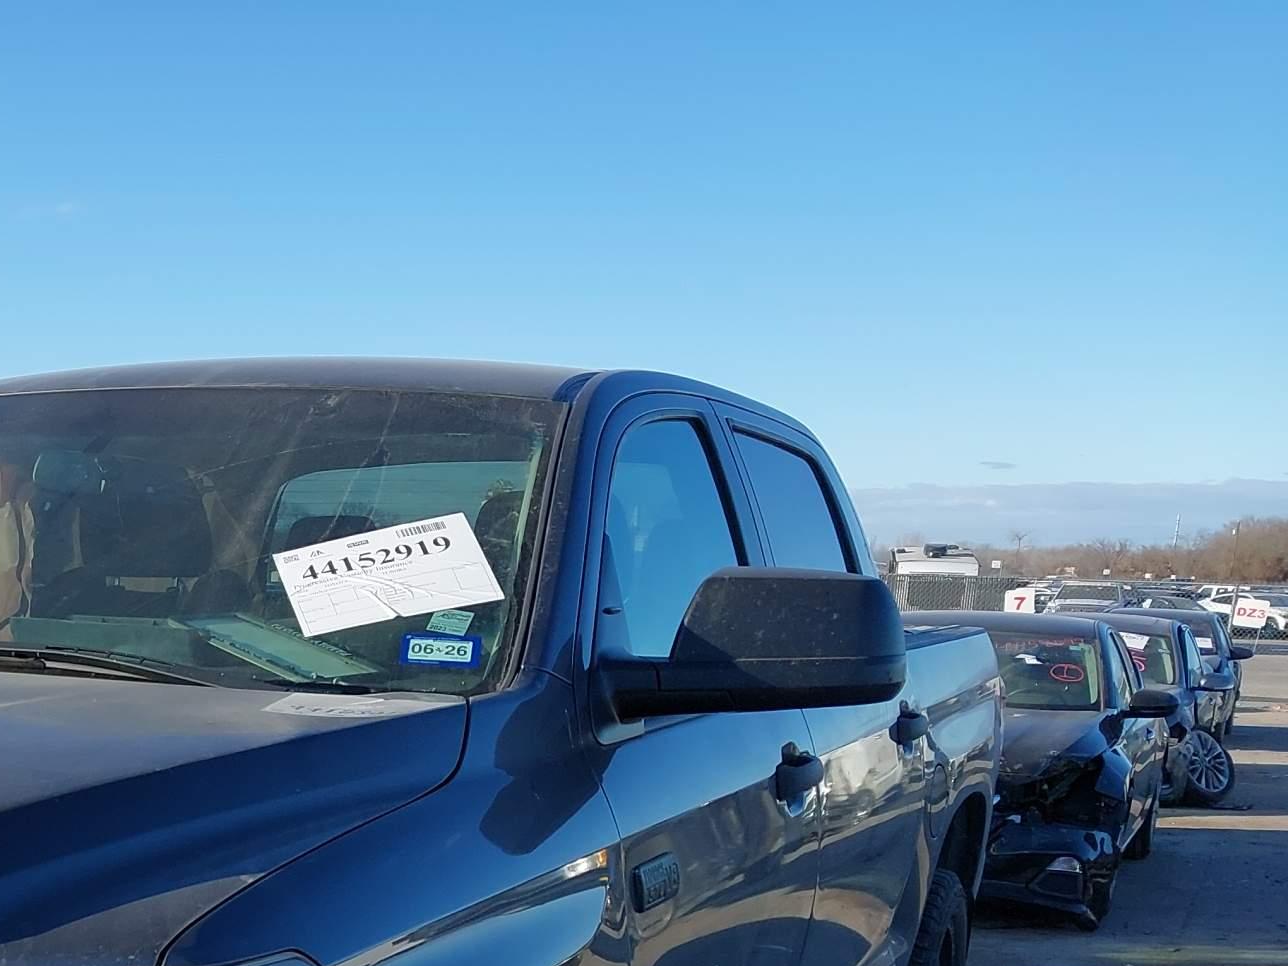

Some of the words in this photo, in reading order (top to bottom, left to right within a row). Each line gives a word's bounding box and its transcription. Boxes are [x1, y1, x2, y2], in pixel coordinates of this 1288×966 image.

[301, 536, 451, 580] 44152919
[1014, 596, 1027, 611] 7
[1236, 607, 1267, 619] DZ3
